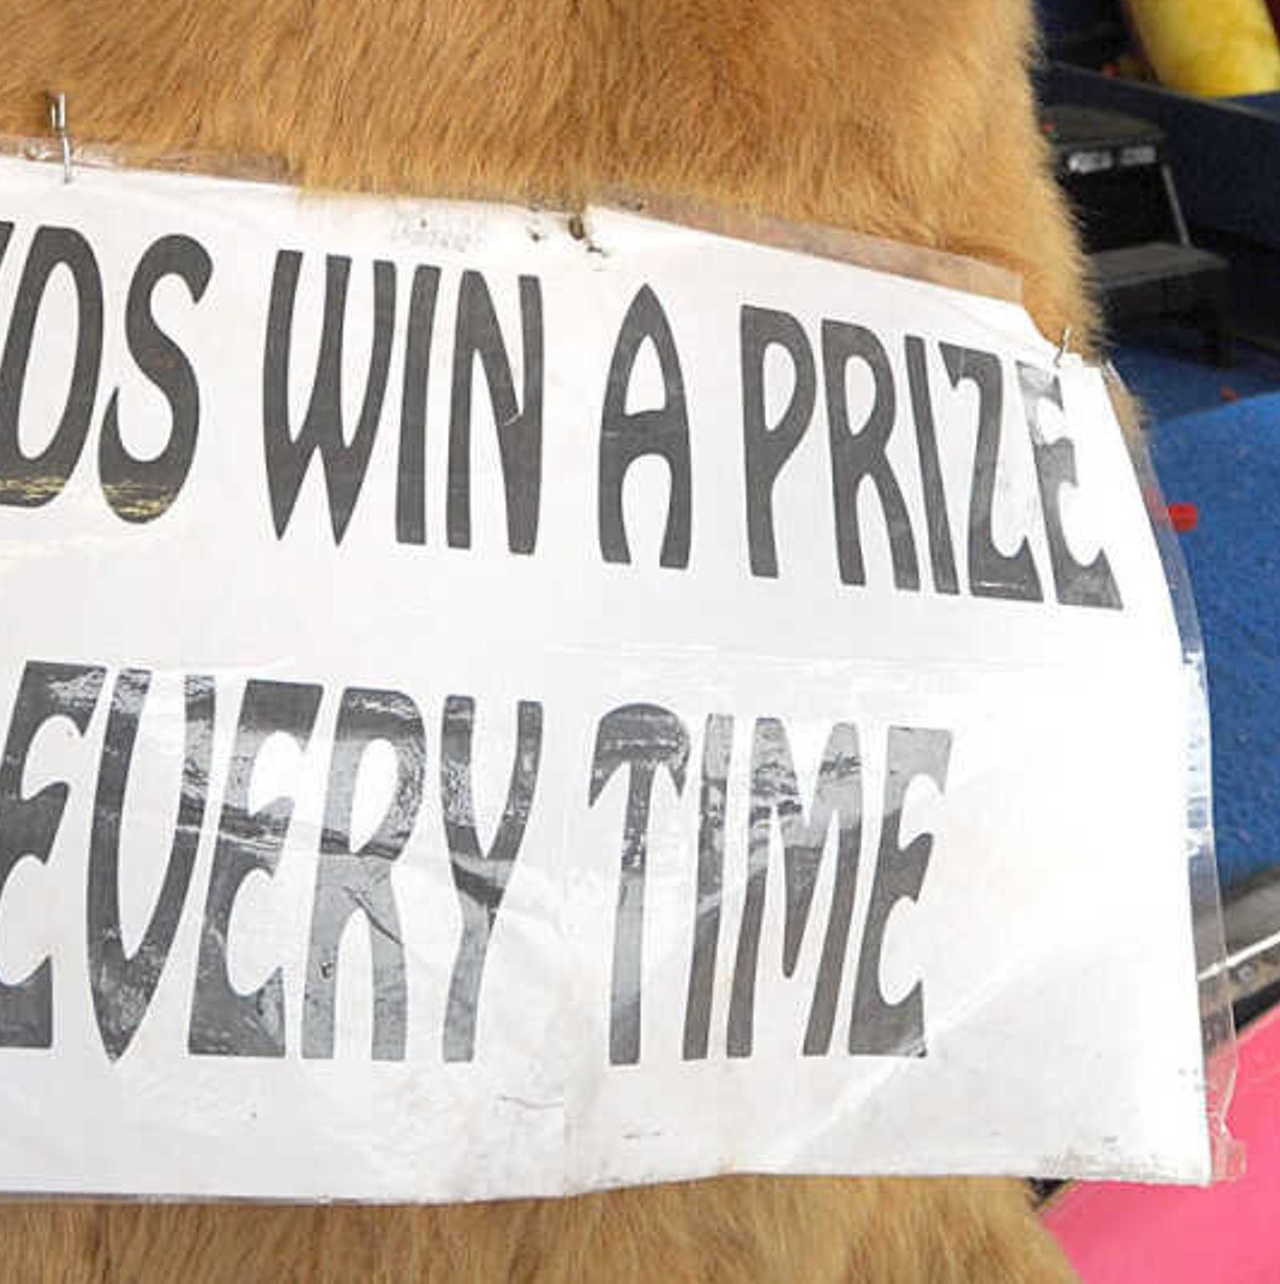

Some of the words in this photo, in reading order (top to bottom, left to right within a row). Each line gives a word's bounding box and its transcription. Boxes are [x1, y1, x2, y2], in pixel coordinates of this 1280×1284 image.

[262, 249, 545, 557] WIN
[598, 284, 692, 569] A
[741, 305, 1123, 610] PRIZE
[587, 702, 952, 1066] TIME
